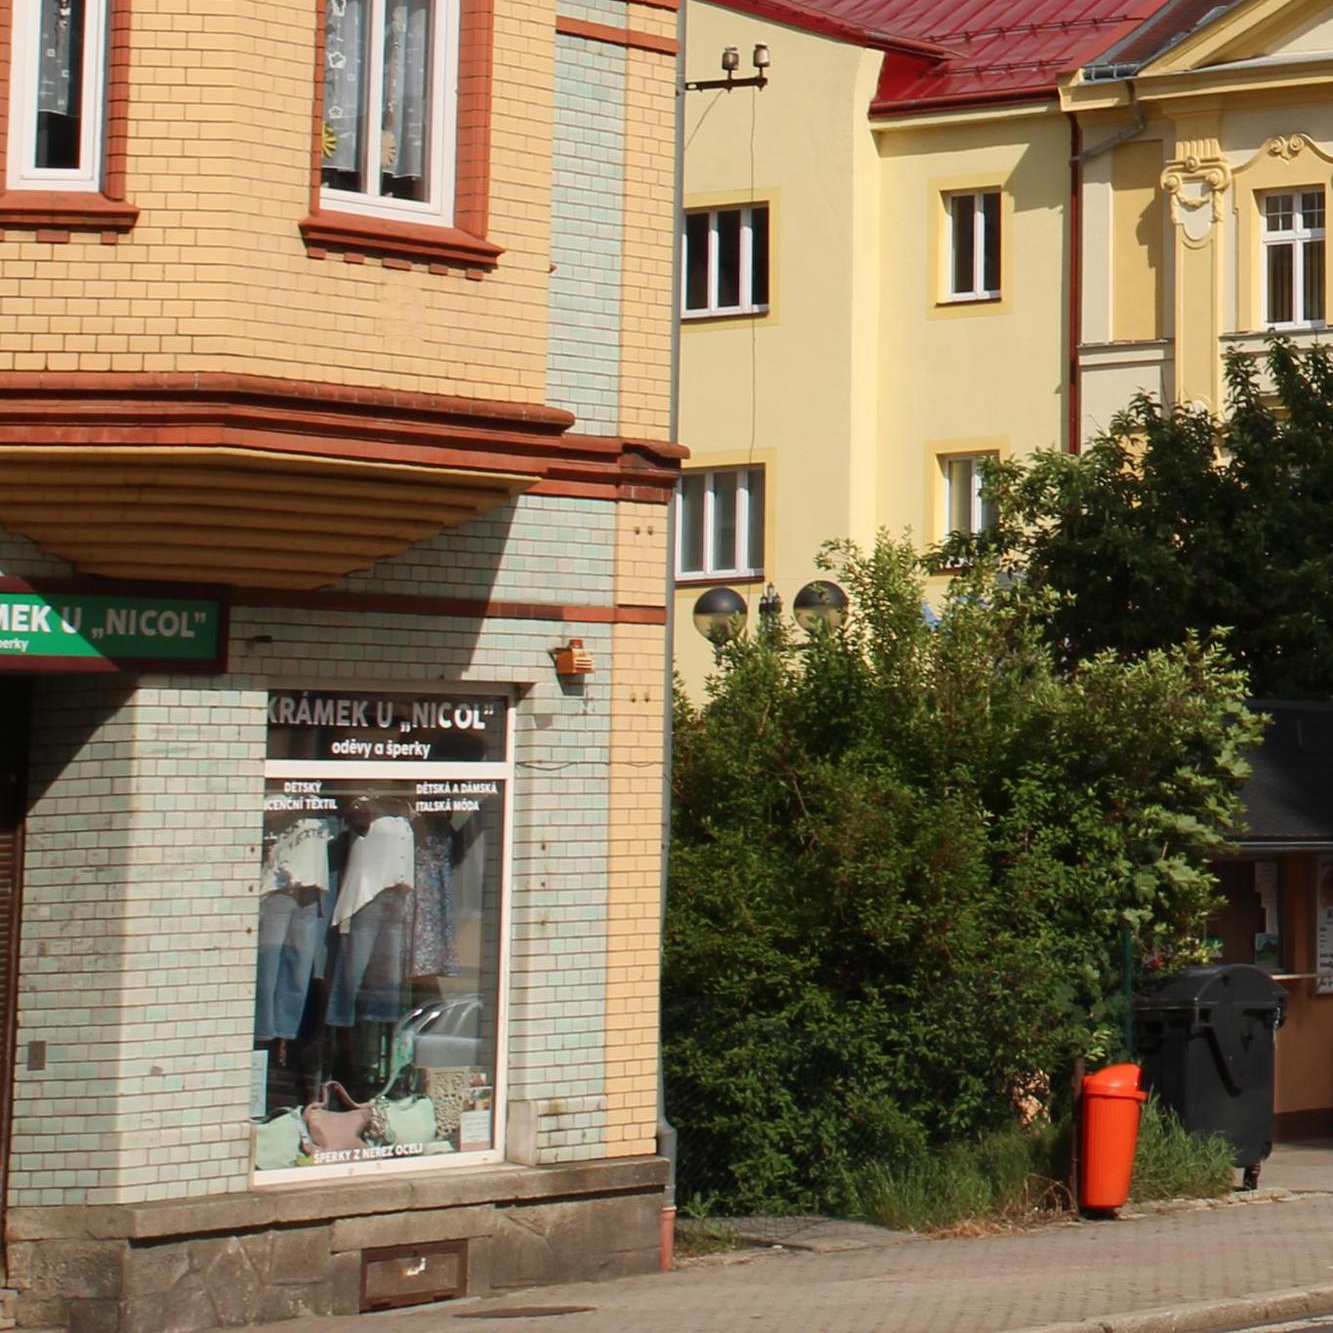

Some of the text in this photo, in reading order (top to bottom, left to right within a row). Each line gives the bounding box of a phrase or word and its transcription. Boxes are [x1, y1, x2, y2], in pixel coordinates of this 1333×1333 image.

[61, 607, 82, 634] U
[0, 637, 29, 652] erky
[376, 702, 393, 728] U
[332, 739, 431, 759] oděvy a šperky
[452, 783, 460, 794] A
[305, 798, 338, 810] TEXTIL
[415, 798, 480, 812] ITALSKÁ MÓDA
[314, 1142, 423, 1164] ŠPERKY Z NEREZ OCELI
